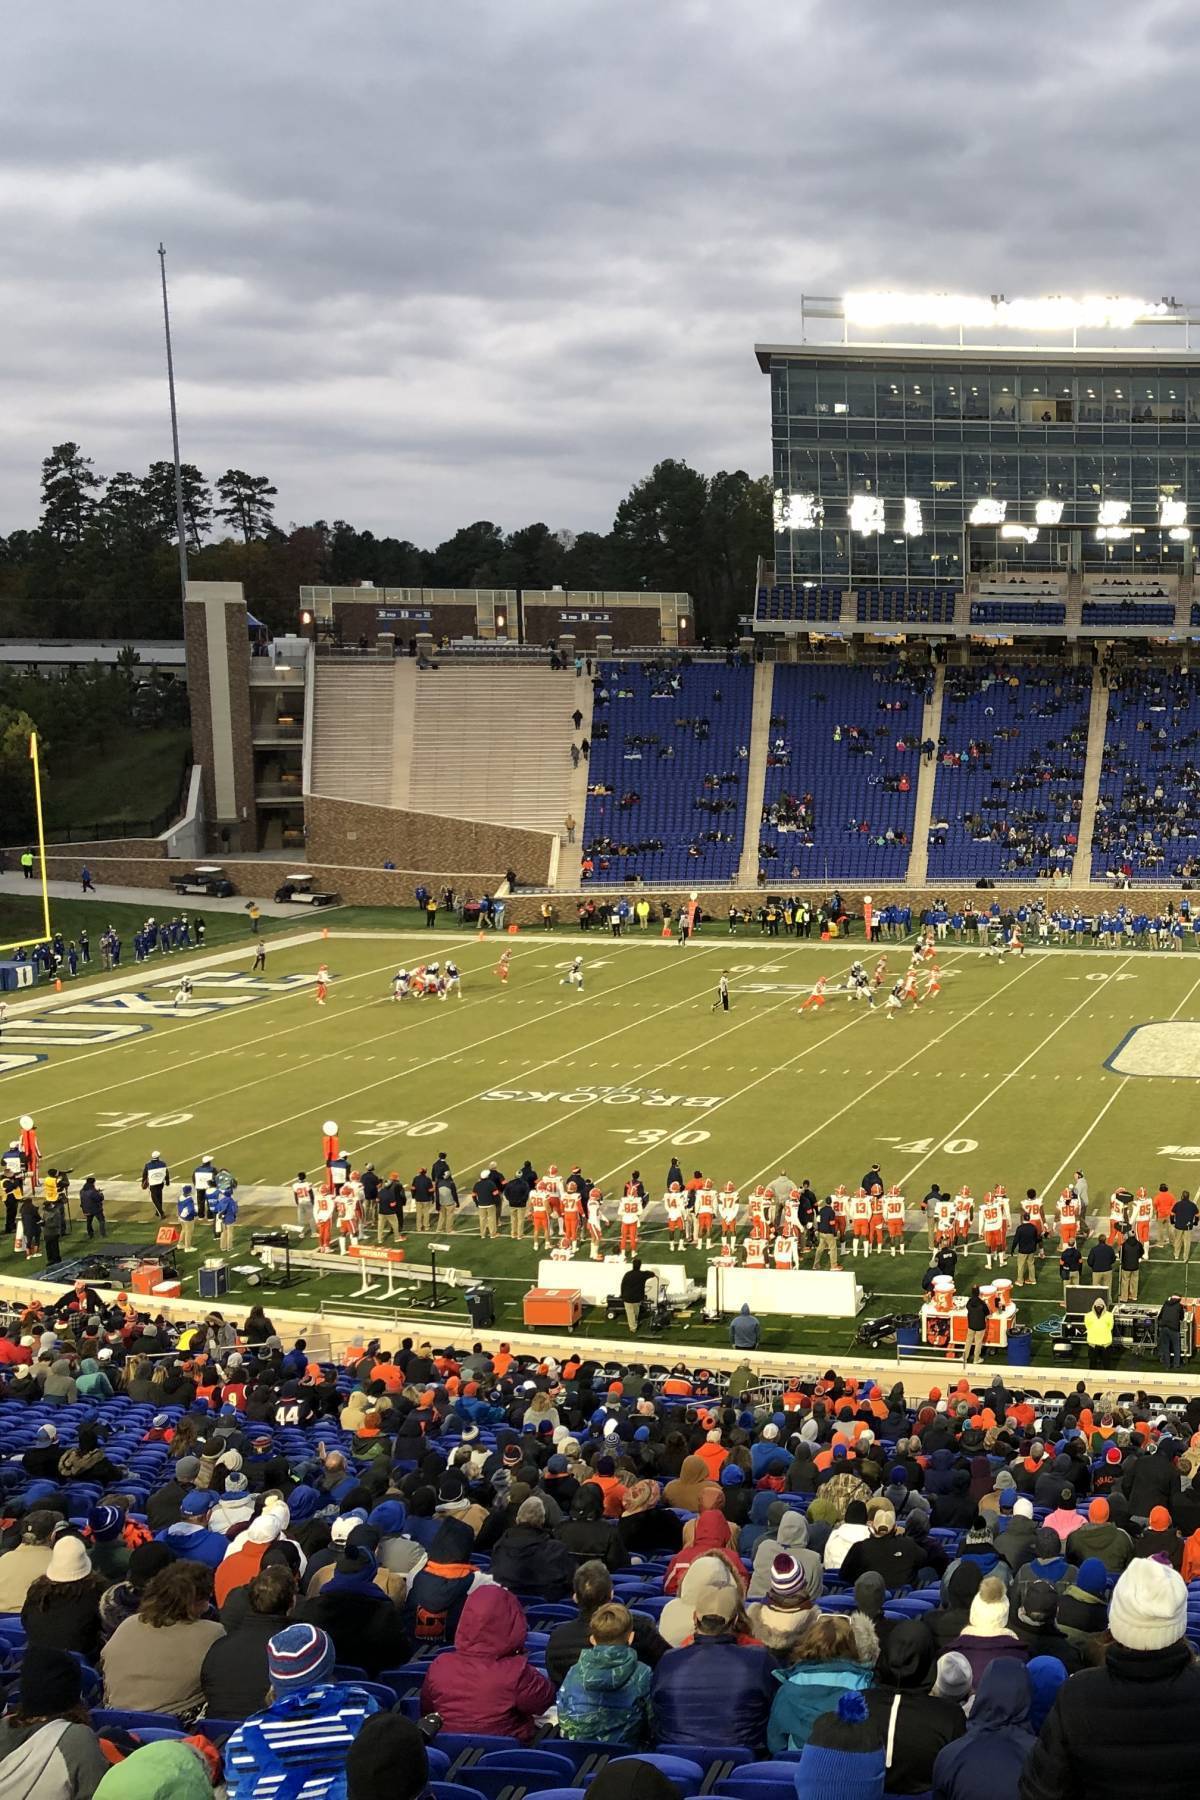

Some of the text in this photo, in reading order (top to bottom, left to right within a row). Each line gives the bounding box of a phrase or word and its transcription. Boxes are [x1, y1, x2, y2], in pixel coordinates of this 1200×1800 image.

[480, 1090, 727, 1109] BROOKS
[97, 1112, 194, 1128] 10
[353, 1120, 449, 1137] 20
[624, 1128, 712, 1146] 30
[891, 1137, 979, 1154] 40
[159, 1228, 172, 1240] 20
[748, 1244, 760, 1256] 51
[275, 1405, 299, 1426] 44
